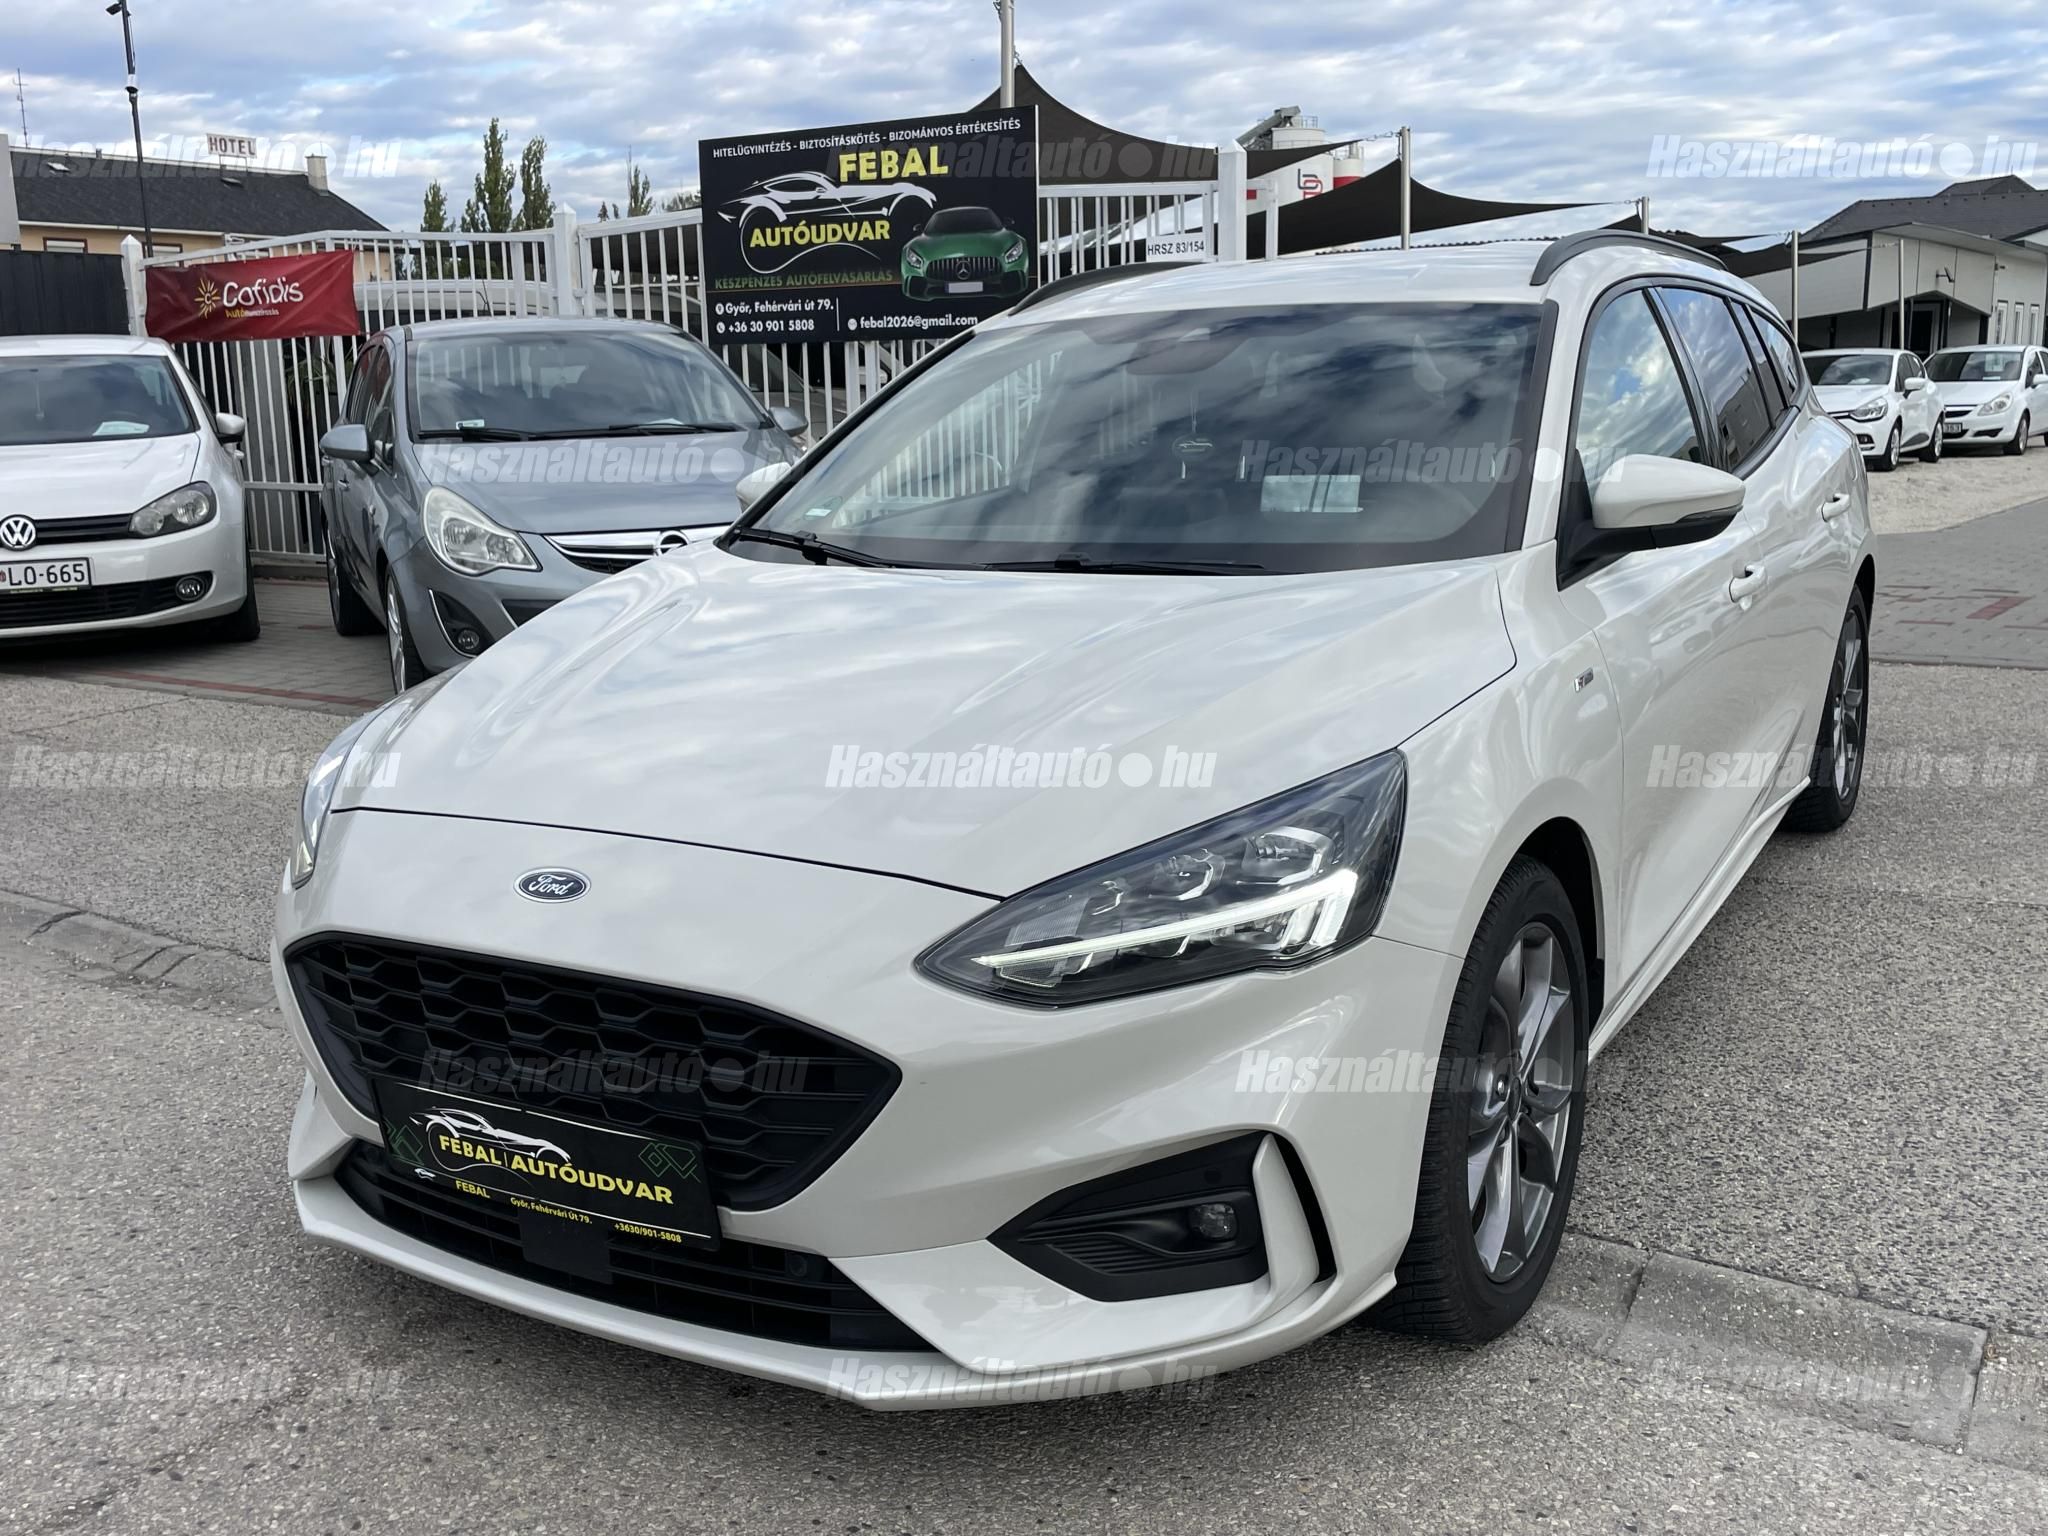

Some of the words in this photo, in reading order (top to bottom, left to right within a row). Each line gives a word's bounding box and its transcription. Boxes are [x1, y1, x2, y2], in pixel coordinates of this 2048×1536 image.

[209, 136, 256, 156] HOTEL
[713, 140, 792, 158] HITELÜGYINTÉZÉS
[799, 131, 880, 150] BIZTOSÍTÁSKÖTÉS
[889, 126, 954, 142] BIZOMÁNYOS
[955, 117, 1021, 135] ÉRTÉKESÍTÉS
[838, 145, 949, 183] FEBAL
[750, 219, 891, 248] AUTÓUDVAR
[1147, 242, 1174, 256] HRSZ
[1175, 240, 1205, 253] 83/154
[222, 276, 304, 307] Cofidis
[725, 301, 752, 317] Győr,
[754, 299, 802, 313] Fehérvári
[804, 300, 815, 311] út
[817, 298, 834, 311] 79.
[728, 321, 748, 333] +36
[750, 320, 764, 332] 30
[766, 320, 785, 332] 901
[788, 319, 815, 331] 5808
[859, 314, 979, 330] febal2026@gmail.com
[528, 874, 575, 896] Ford
[439, 1134, 502, 1166] FEBAL
[511, 1154, 674, 1205] AUTÓUDVAR
[455, 1180, 491, 1199] FEBAL
[530, 1202, 568, 1220] Fehérvári
[614, 1223, 682, 1244] +3630/901-5808
